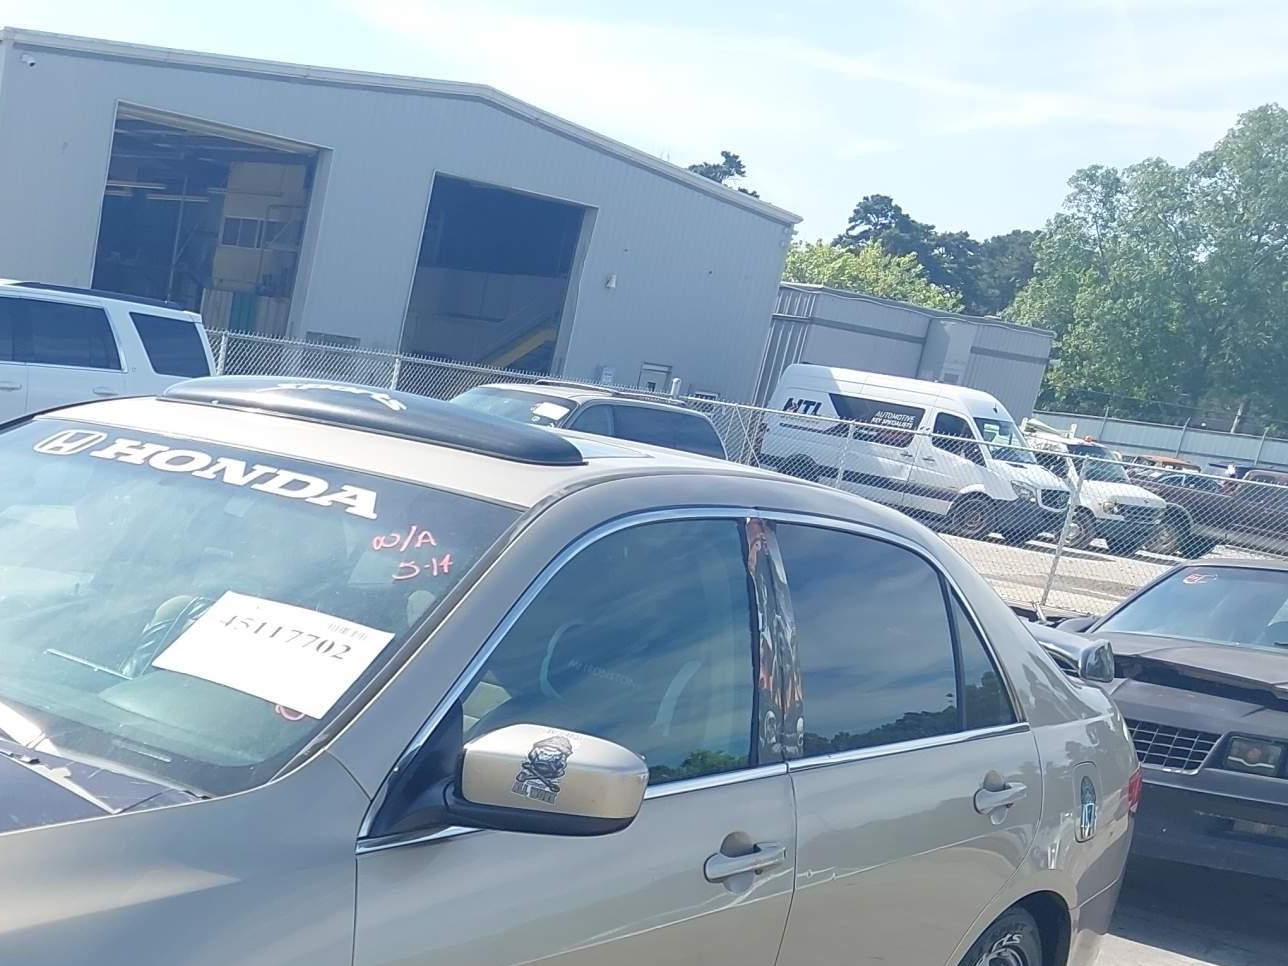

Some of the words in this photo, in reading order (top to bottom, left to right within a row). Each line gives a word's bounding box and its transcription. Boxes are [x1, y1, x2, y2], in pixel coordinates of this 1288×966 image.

[870, 416, 883, 425] KEY
[874, 410, 917, 424] AUTOMOTIVE
[90, 437, 379, 521] HONDA
[218, 614, 354, 662] 45117702
